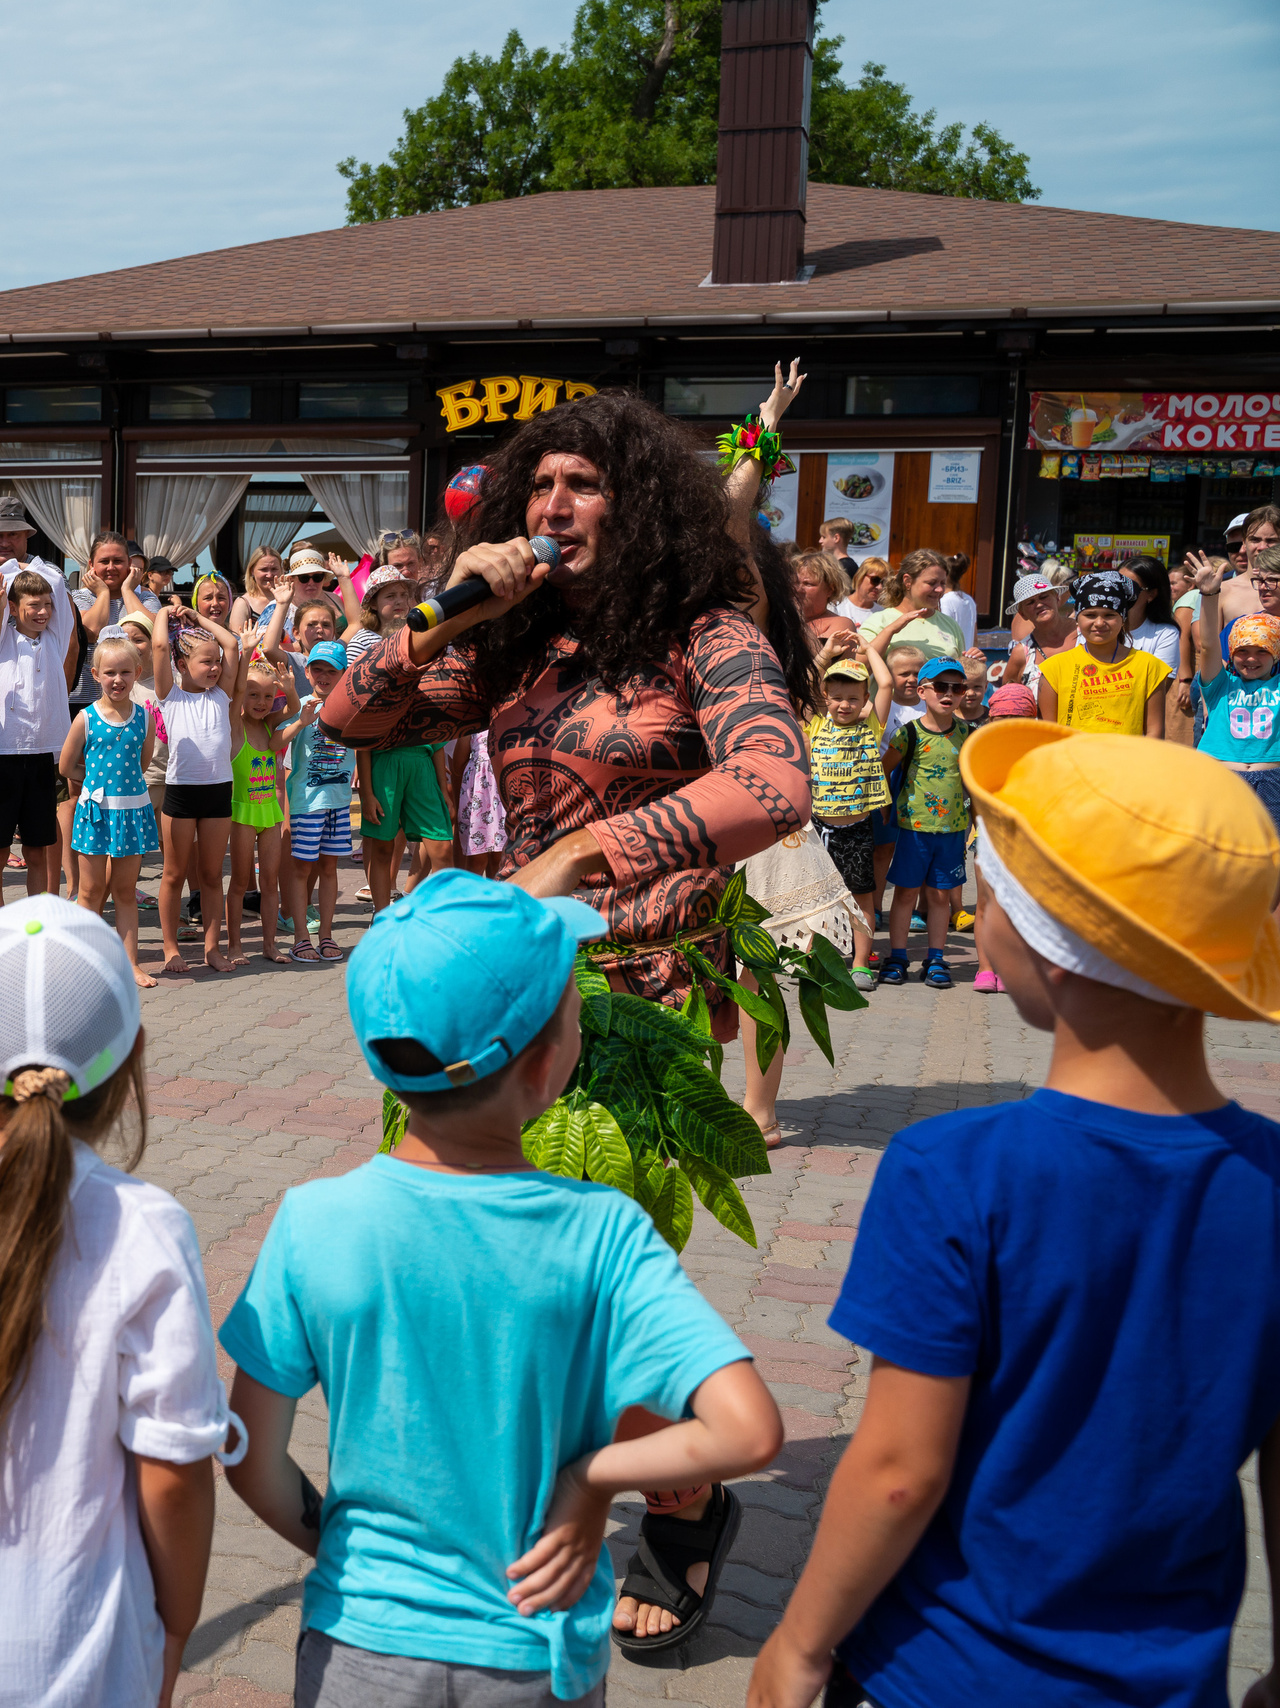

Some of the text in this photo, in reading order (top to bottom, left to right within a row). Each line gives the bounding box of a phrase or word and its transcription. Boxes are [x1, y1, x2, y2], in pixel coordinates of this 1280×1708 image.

[1083, 687, 1108, 696] Black
[1115, 682, 1131, 691] Sea
[1230, 706, 1274, 739] 88
